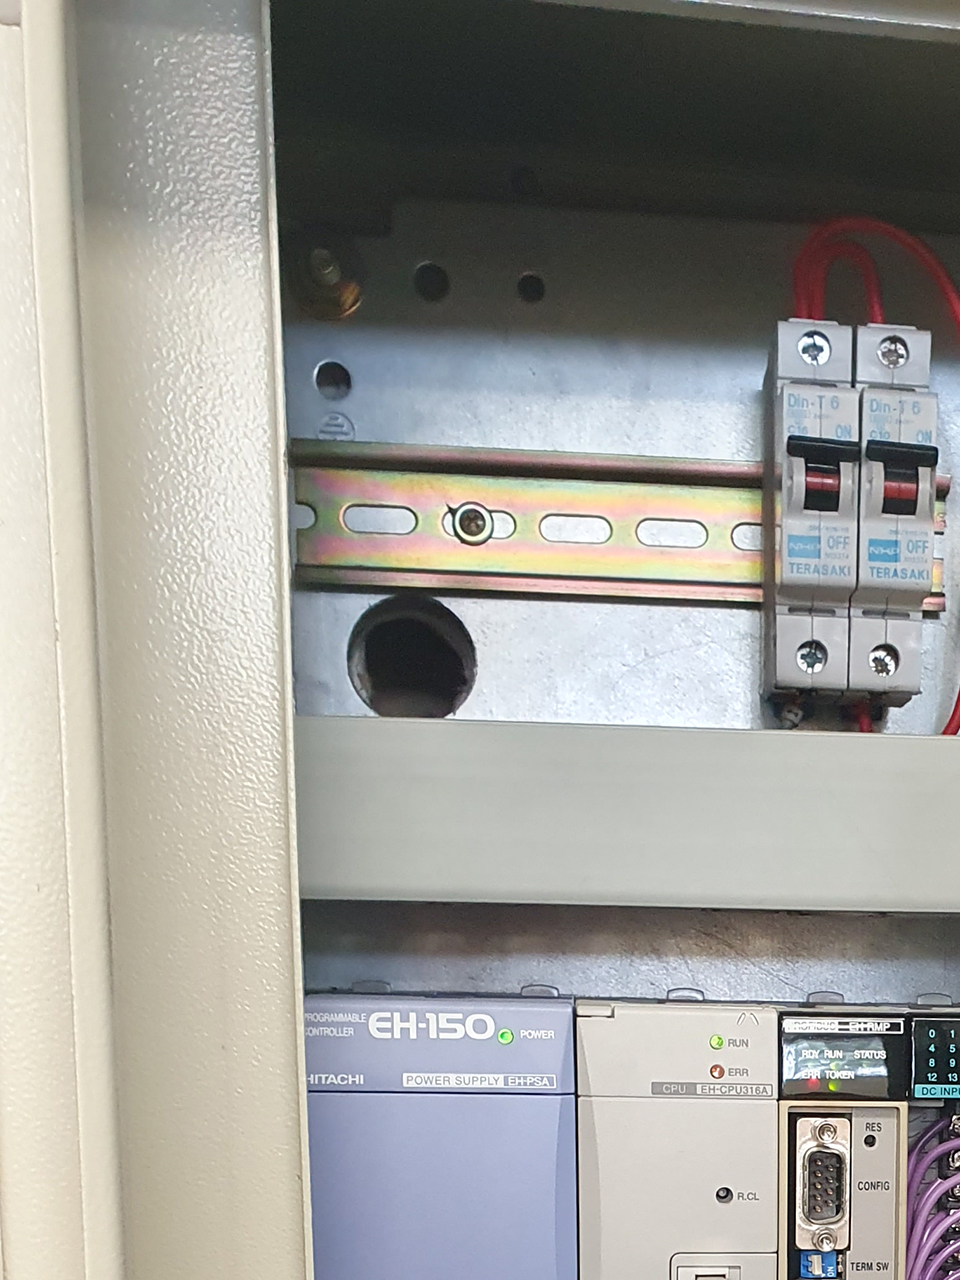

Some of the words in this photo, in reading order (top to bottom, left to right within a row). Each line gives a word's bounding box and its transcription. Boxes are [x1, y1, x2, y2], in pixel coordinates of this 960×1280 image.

[787, 393, 825, 410] Din-T
[830, 395, 839, 409] 6
[869, 398, 906, 414] Din-T
[911, 401, 921, 415] 6
[835, 425, 852, 438] ON
[916, 430, 932, 443] ON
[827, 535, 850, 550] OFF
[906, 539, 929, 554] OFF
[789, 562, 851, 577] TERASAKI
[869, 566, 930, 580] TERASAKI
[368, 1012, 496, 1040] EH-150
[520, 1030, 555, 1040] POWER
[929, 1029, 935, 1038] 0
[950, 1029, 955, 1038] 1
[727, 1038, 749, 1048] RUN
[928, 1044, 935, 1053] 4
[949, 1044, 956, 1053] 5
[802, 1050, 820, 1059] RDY
[824, 1050, 843, 1059] RUN
[853, 1050, 887, 1059] STATUS
[929, 1058, 935, 1067] 8
[949, 1058, 956, 1067] 9
[727, 1067, 749, 1077] ERR
[802, 1070, 821, 1079] ERR
[825, 1070, 855, 1079] TOKEN
[406, 1075, 451, 1086] POWER
[454, 1075, 500, 1087] SUPPLY
[508, 1076, 550, 1087] EH-PSA
[927, 1073, 937, 1082] 12
[948, 1073, 958, 1082] 13
[662, 1084, 687, 1094] CPU
[701, 1085, 768, 1096] EH-CPU316A
[921, 1087, 936, 1096] DC
[866, 1122, 882, 1132] RES
[858, 1181, 890, 1191] CONFIG
[737, 1192, 759, 1202] R.CL
[827, 1266, 835, 1277] ON
[851, 1262, 874, 1271] TERM
[876, 1262, 889, 1271] SW
